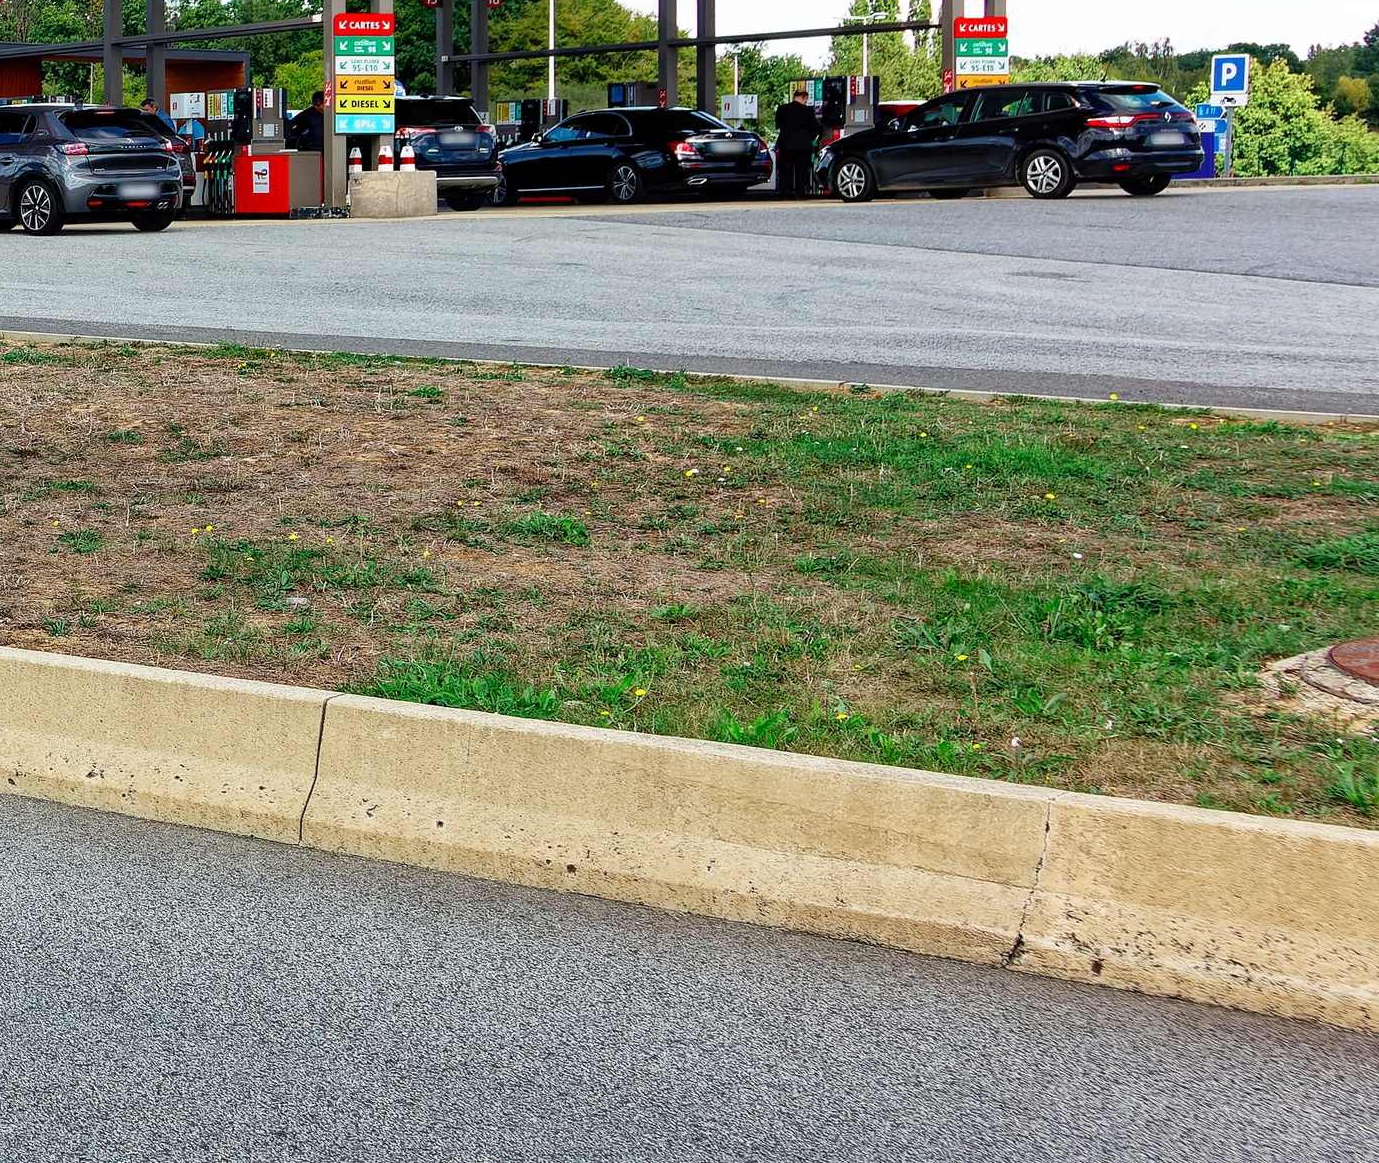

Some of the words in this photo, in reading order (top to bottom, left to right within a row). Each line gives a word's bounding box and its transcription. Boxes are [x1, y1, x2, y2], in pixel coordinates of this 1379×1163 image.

[349, 21, 380, 30] CARTES
[968, 23, 996, 32] CARTES
[1221, 62, 1238, 87] P
[351, 100, 379, 108] DIESEL
[354, 119, 377, 129] GPLc
